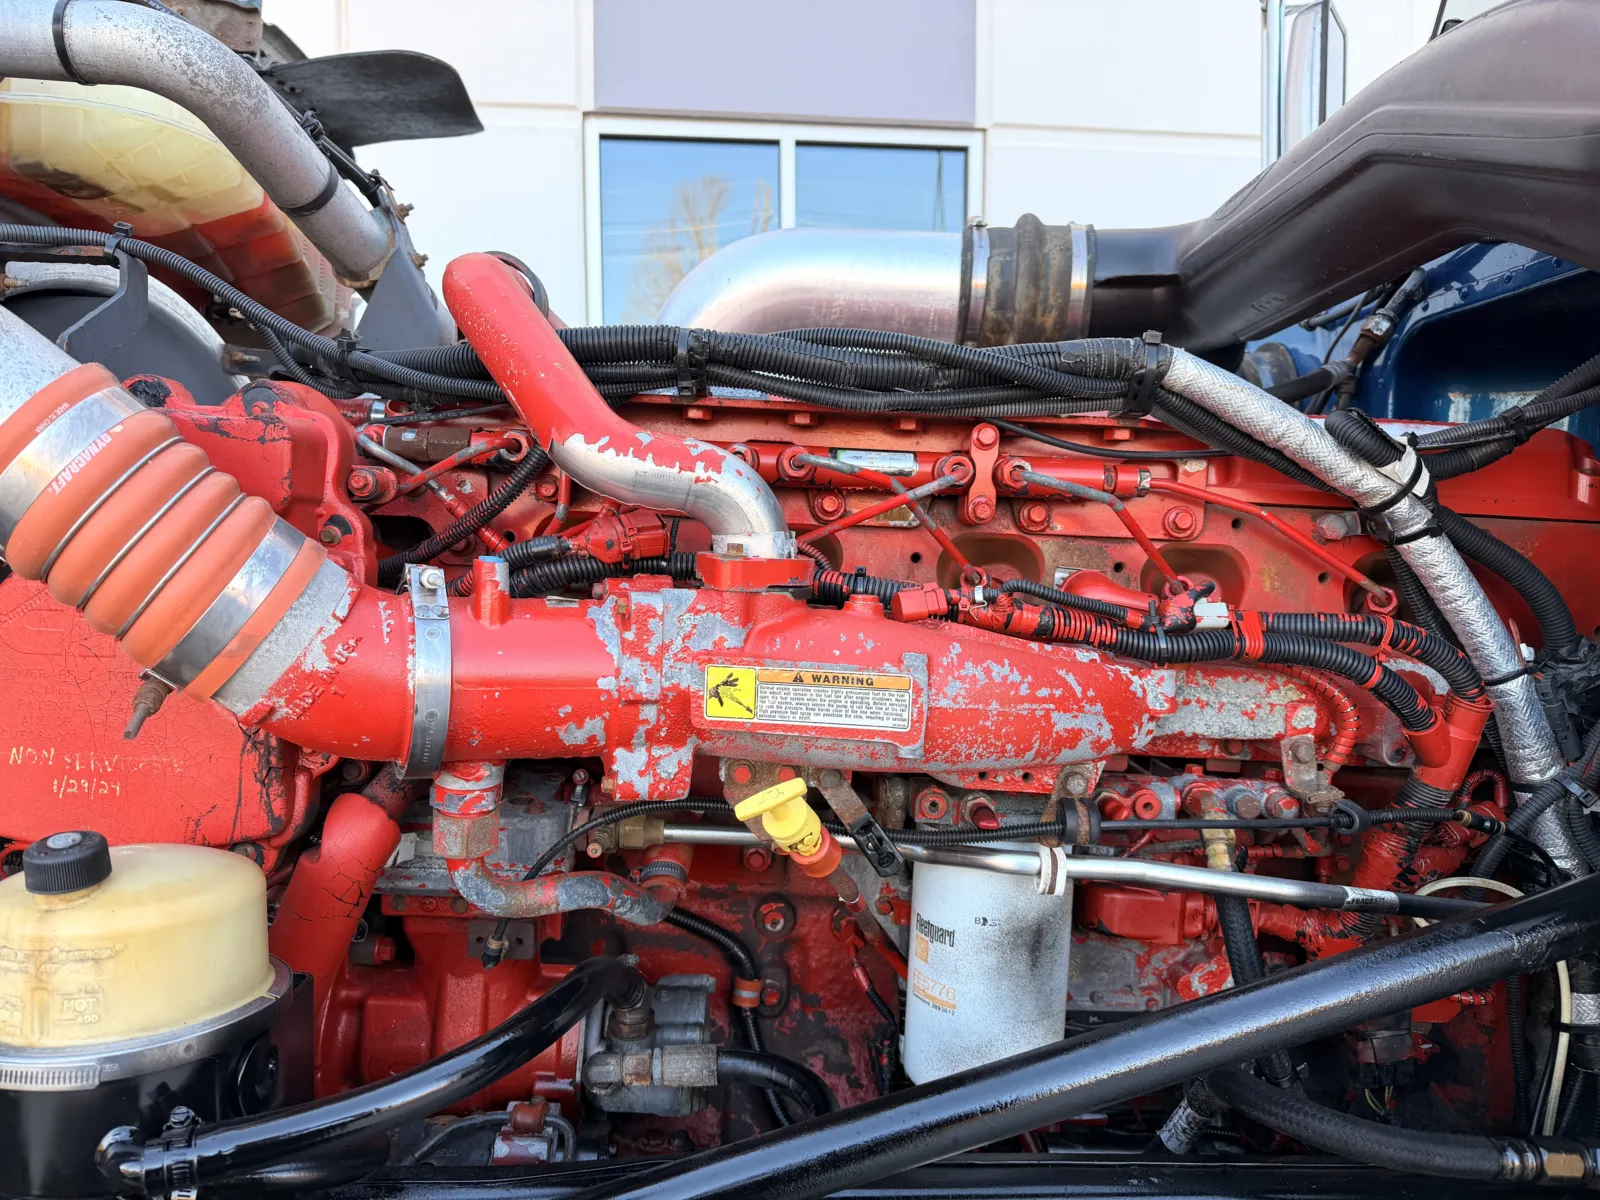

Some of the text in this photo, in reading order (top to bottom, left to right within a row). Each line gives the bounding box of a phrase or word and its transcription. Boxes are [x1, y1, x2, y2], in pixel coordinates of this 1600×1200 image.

[51, 433, 112, 495] DYNACRAFT
[811, 674, 874, 687] WARNING
[9, 746, 54, 765] NON
[53, 775, 120, 799] 1/29/24
[915, 912, 956, 948] Fleetguard
